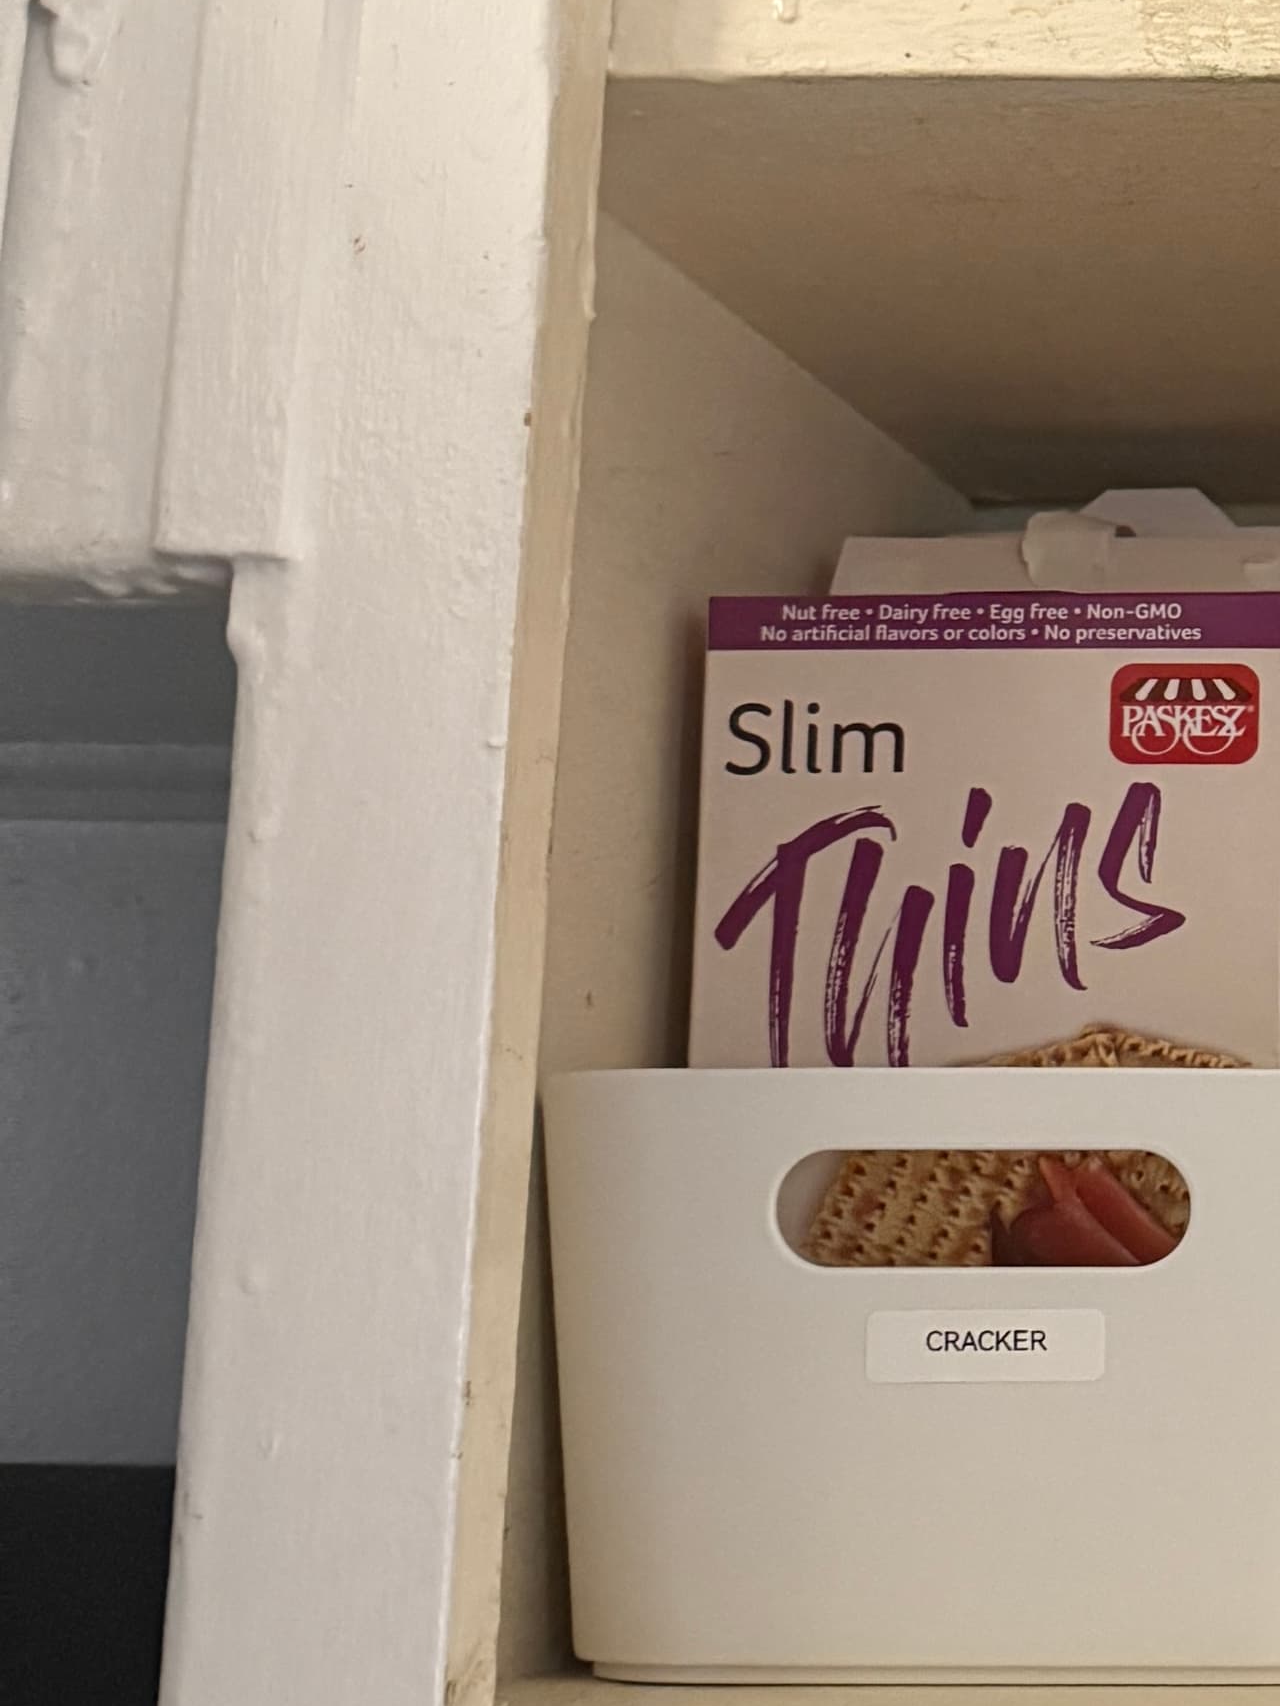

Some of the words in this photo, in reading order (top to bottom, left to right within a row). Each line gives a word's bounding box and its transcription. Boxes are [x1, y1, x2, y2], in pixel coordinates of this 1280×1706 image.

[782, 604, 817, 621] Nut
[821, 603, 861, 621] free
[879, 604, 929, 624] Dairy
[932, 603, 972, 621] free
[989, 603, 1025, 624] Egg
[1029, 603, 1069, 620] free
[1086, 602, 1183, 620] Non-GMO
[760, 626, 788, 642] No
[791, 624, 870, 642] artificial
[874, 624, 939, 642] flavors
[942, 628, 965, 642] or
[967, 624, 1027, 641] colors
[1043, 624, 1071, 641] No
[1075, 623, 1203, 645] preservatives
[724, 699, 906, 776] Slim
[1120, 704, 1249, 757] PASKESZ
[714, 781, 1187, 1068] Thins
[925, 1330, 1048, 1353] CRACKER
